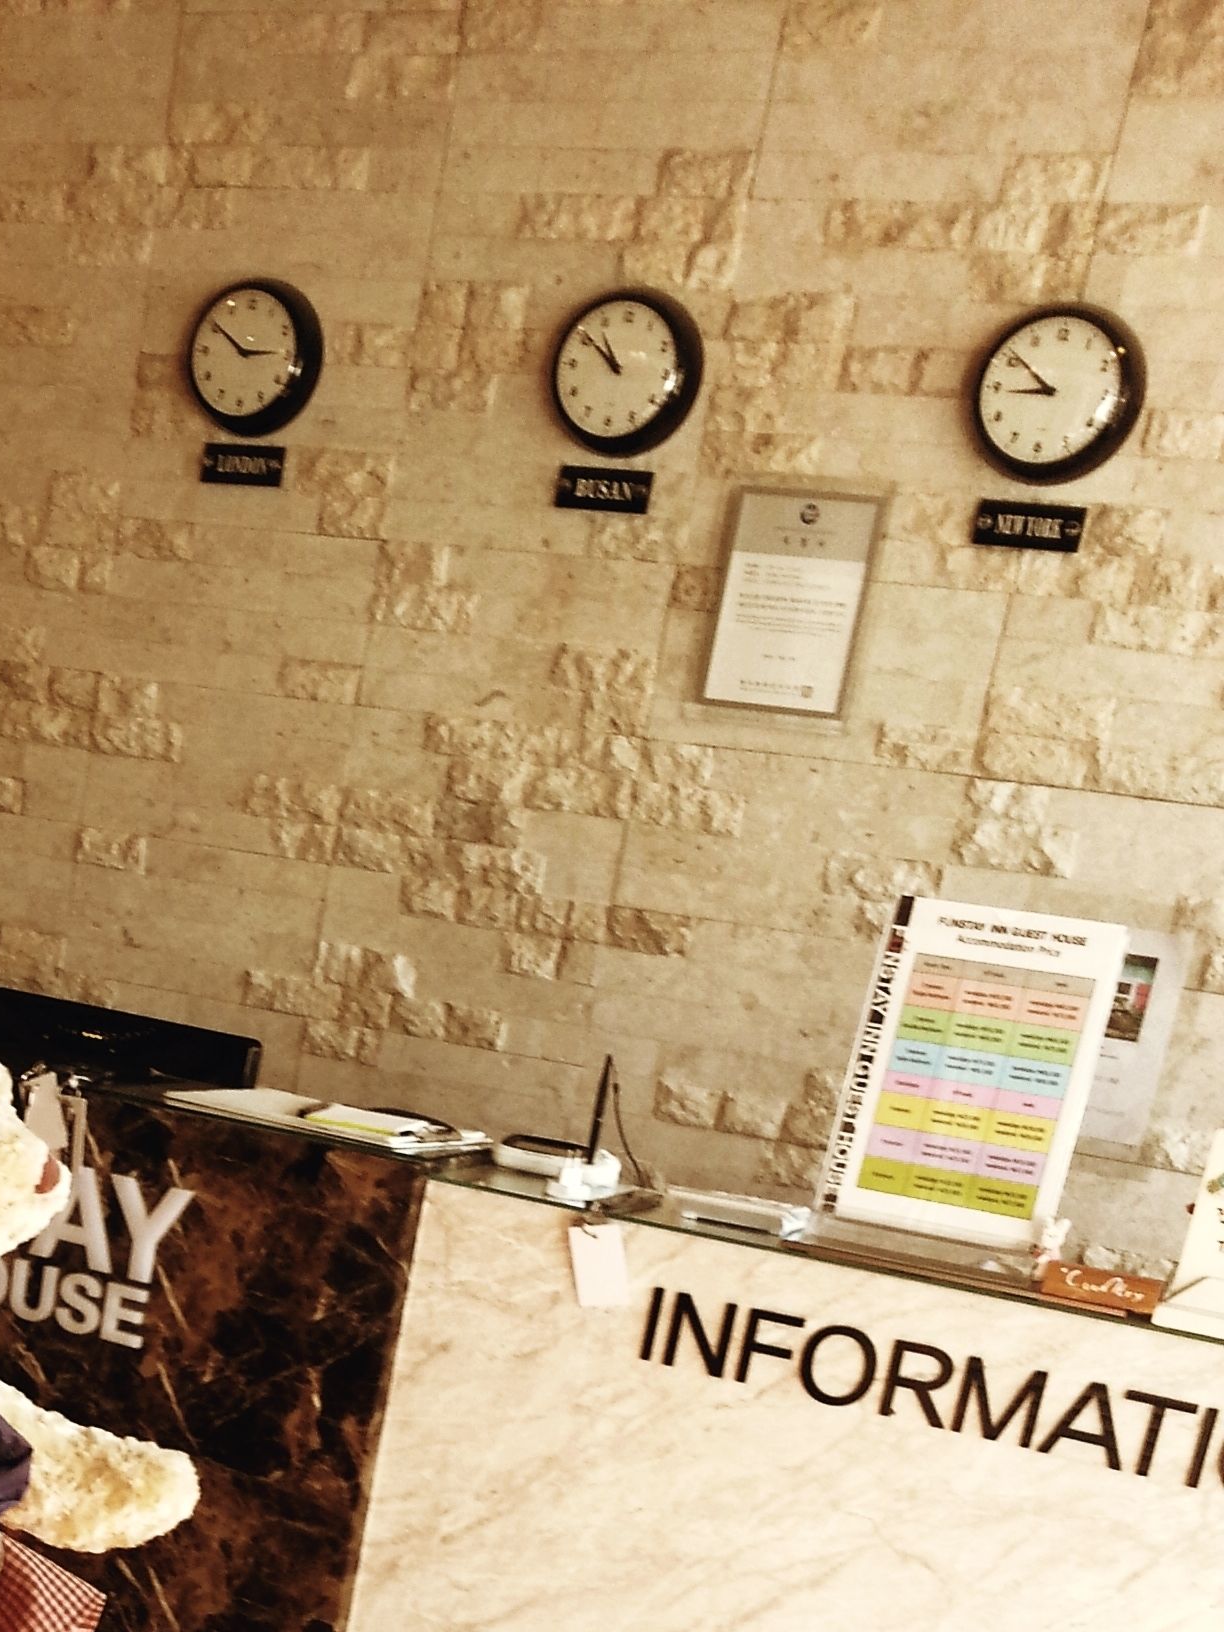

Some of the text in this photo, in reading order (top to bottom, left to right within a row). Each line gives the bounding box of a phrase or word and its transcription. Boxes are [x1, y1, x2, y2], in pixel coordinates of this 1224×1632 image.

[217, 454, 266, 474] LONDON
[574, 478, 632, 501] BUSAN
[994, 513, 1064, 539] NEW YORK
[1011, 927, 1047, 940] GUEST
[1052, 933, 1088, 946] HOUSE
[29, 1165, 196, 1283] AY
[639, 1286, 1224, 1490] INFORMATI
